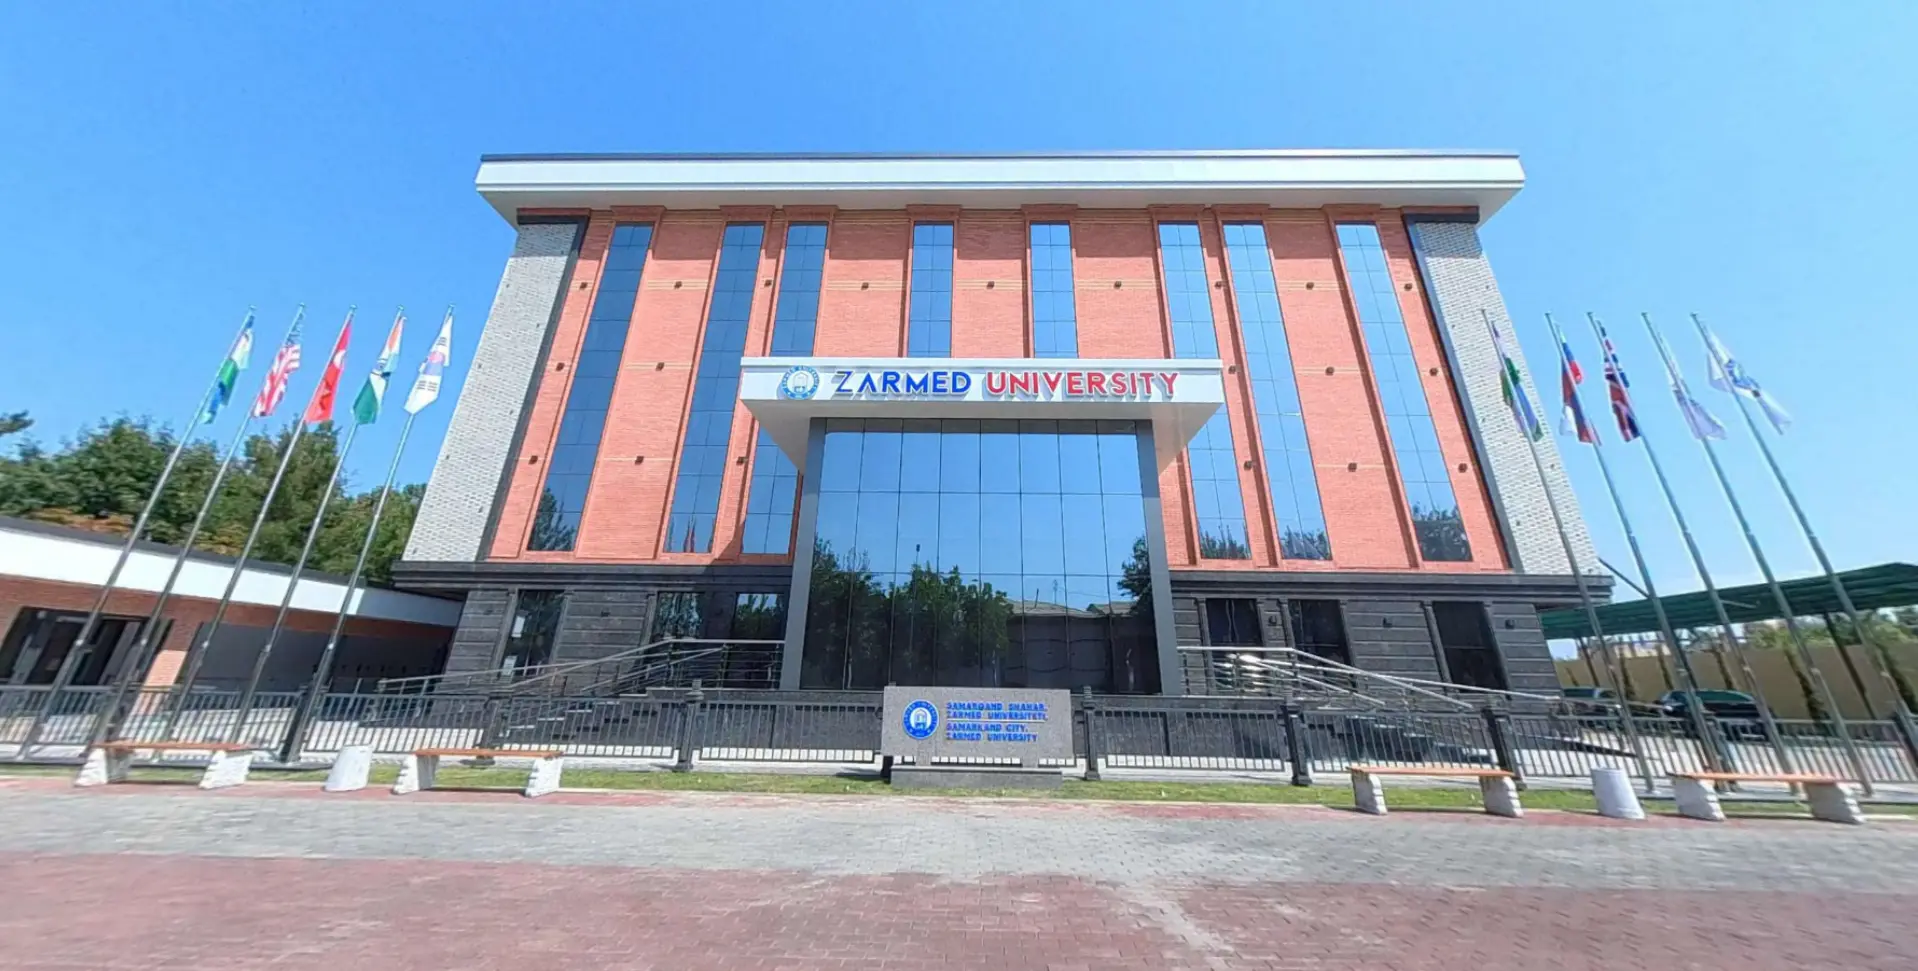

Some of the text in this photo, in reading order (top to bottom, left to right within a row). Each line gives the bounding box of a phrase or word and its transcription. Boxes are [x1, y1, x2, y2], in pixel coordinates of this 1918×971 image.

[836, 371, 972, 393] ZARMED
[987, 372, 1179, 394] UNIVERSITY
[987, 733, 1038, 742] UNIVERSITY
